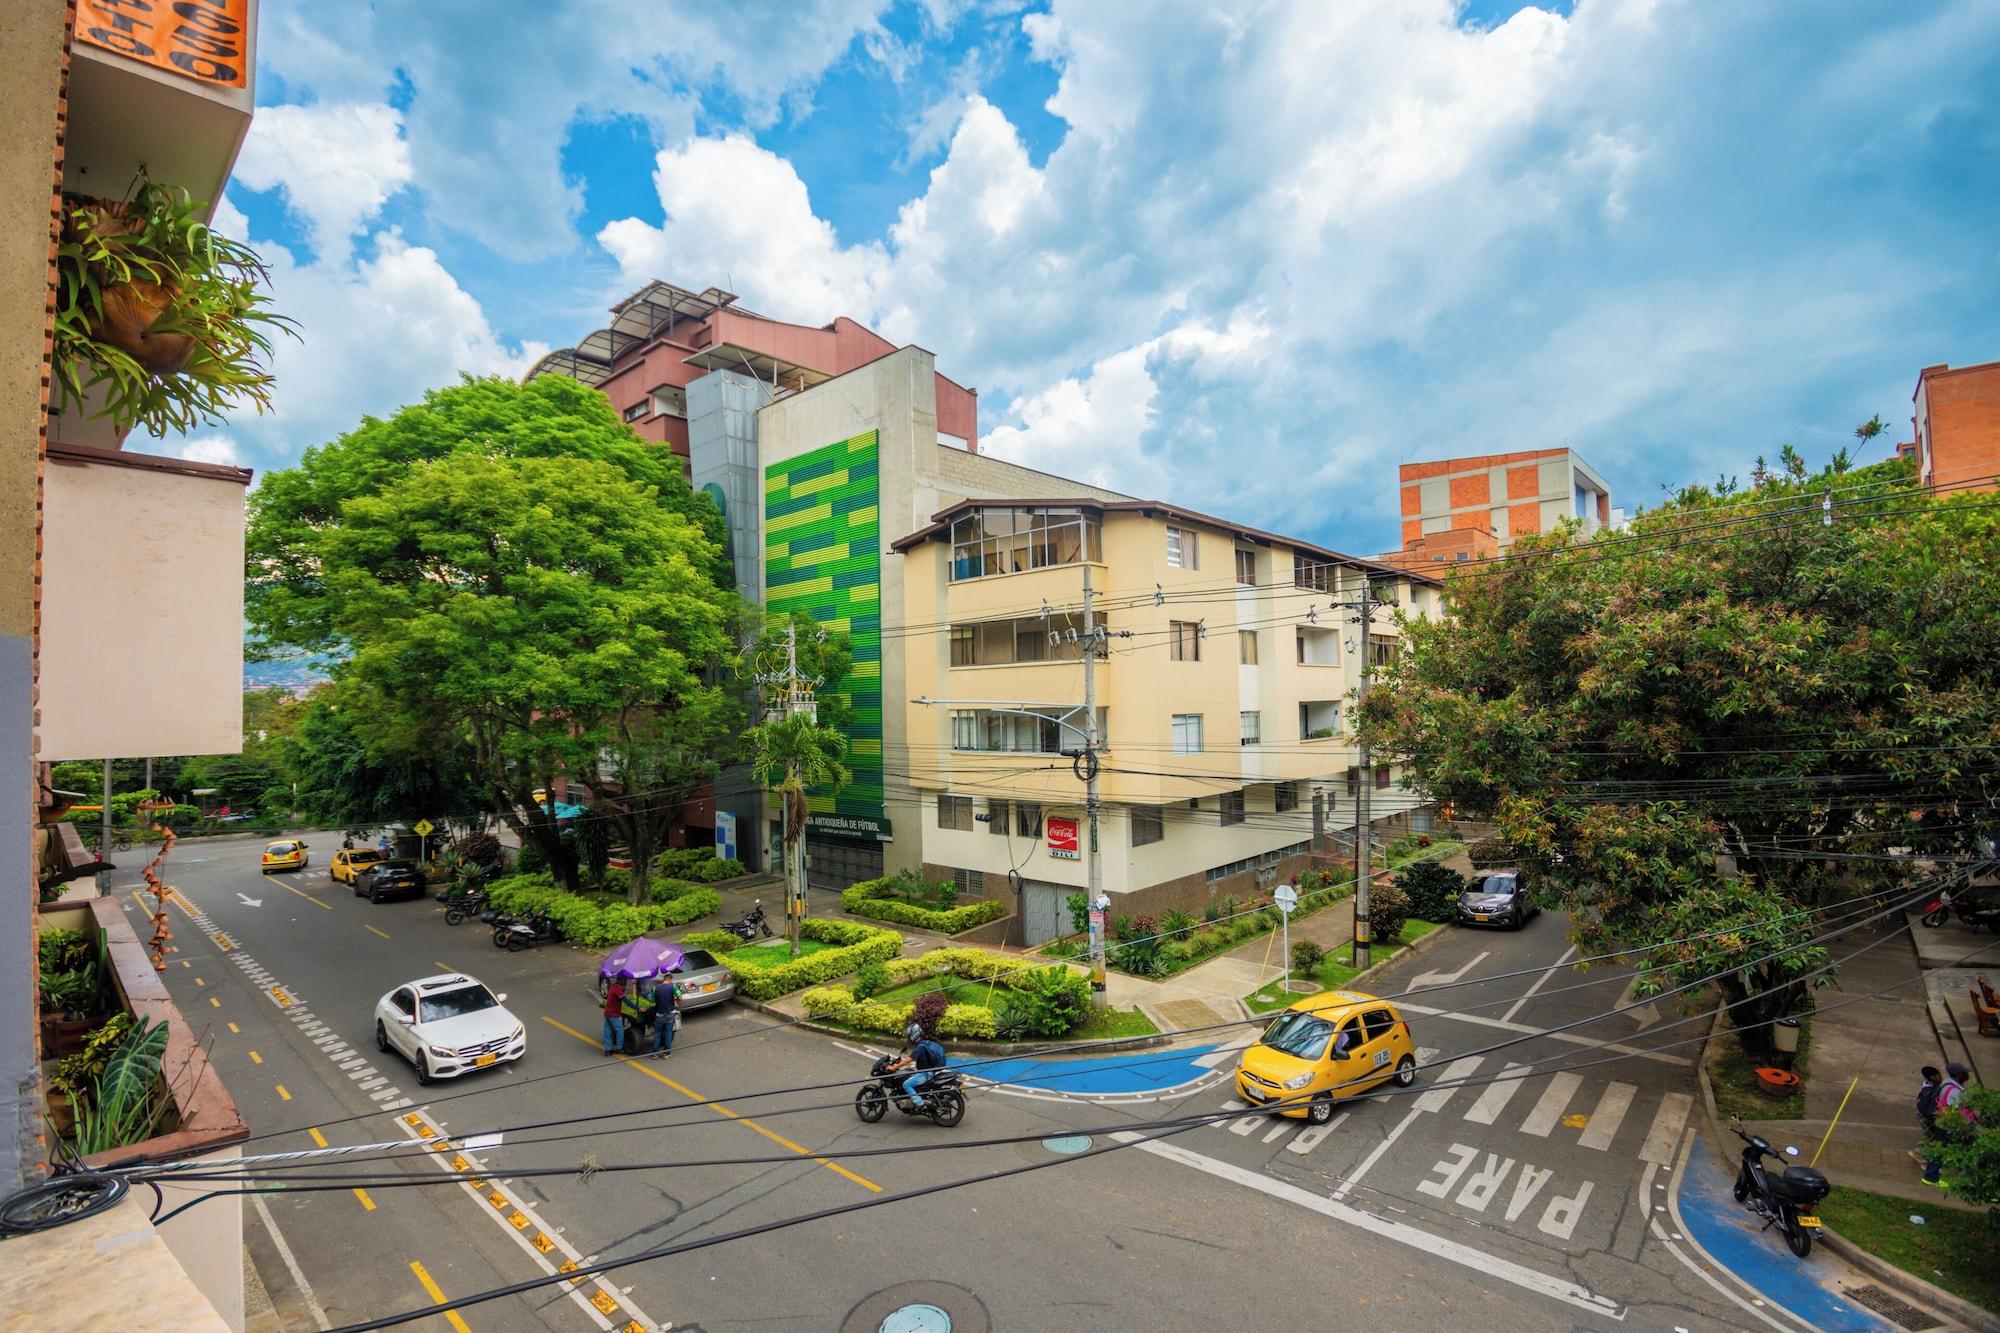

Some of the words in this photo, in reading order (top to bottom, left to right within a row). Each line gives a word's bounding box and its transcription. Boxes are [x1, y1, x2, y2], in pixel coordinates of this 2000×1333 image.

[815, 816, 849, 828] ANTIOQUEÑA
[849, 820, 857, 829] DE
[858, 819, 880, 832] FÚTBOL
[1049, 827, 1073, 838] Coca-Cola
[1416, 1142, 1595, 1240] PARE
